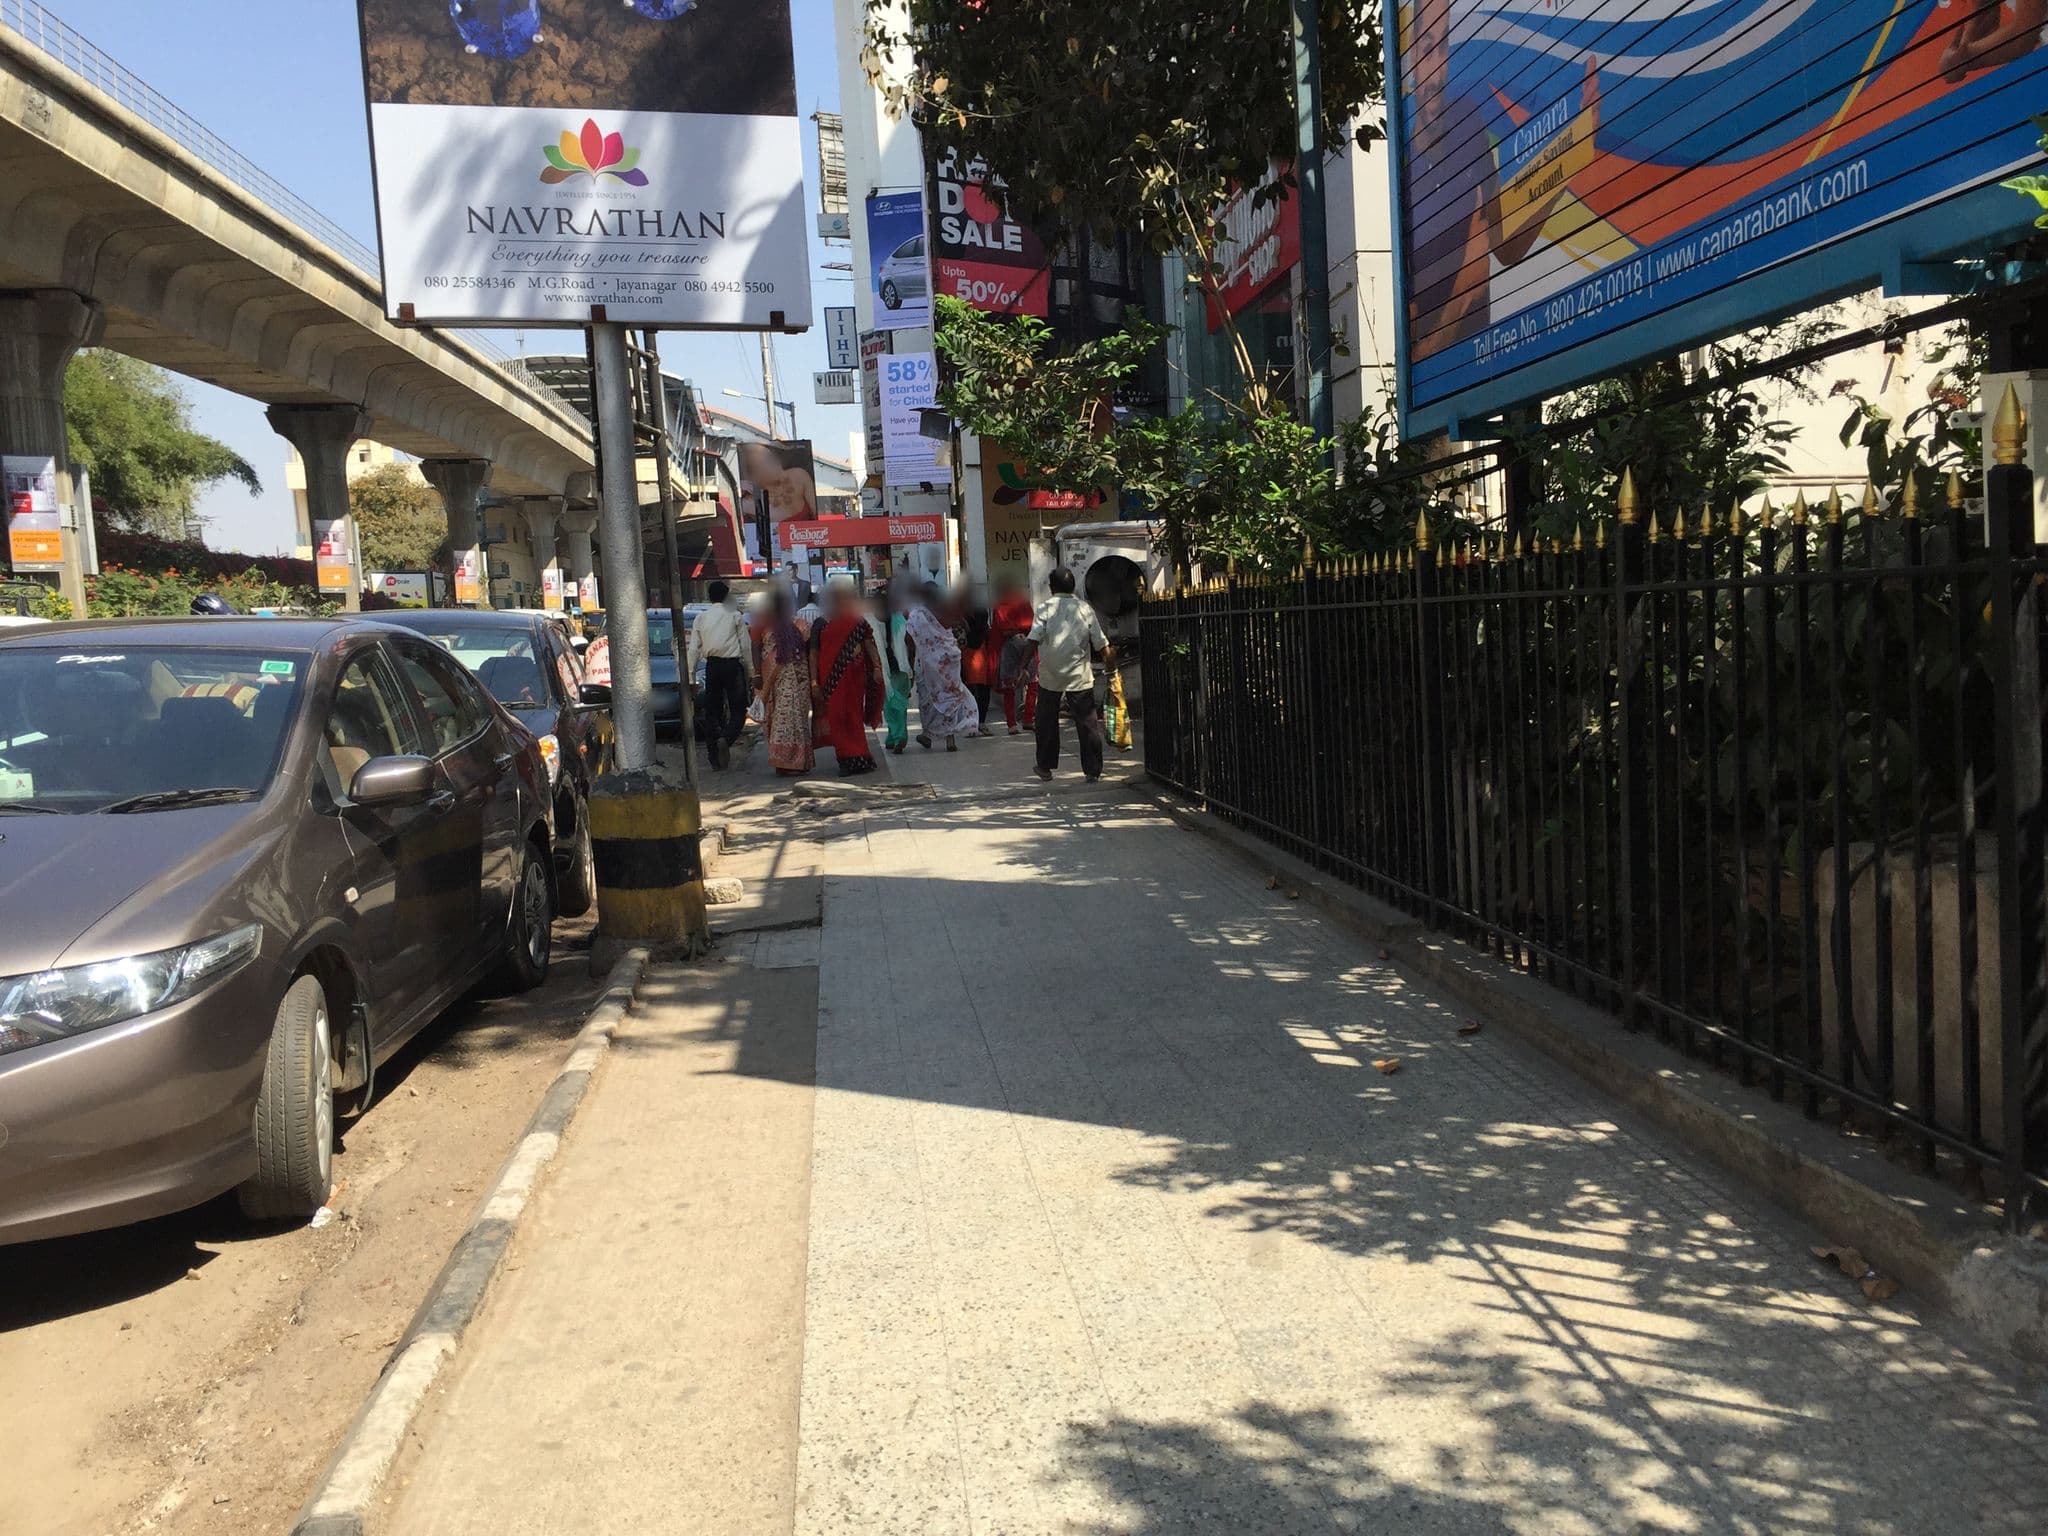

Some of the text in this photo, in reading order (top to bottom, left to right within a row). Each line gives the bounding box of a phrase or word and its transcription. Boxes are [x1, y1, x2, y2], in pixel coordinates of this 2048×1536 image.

[1514, 97, 1568, 164] Canara
[1514, 159, 1543, 194] Junior
[1528, 164, 1563, 202] Account
[467, 206, 726, 240] NAVRATHAN
[941, 216, 1022, 252] SALE
[491, 243, 710, 268] Everything you treasure
[1473, 159, 1868, 366] Toll Free No. 1800 425 0018 www.canarabank.com
[424, 276, 775, 294] 080 25584346 M.G.Road Jayanagar 080 4942 5500
[942, 265, 967, 278] Upto
[544, 292, 664, 305] www.navrathan.com
[888, 383, 931, 396] started
[889, 397, 901, 407] for
